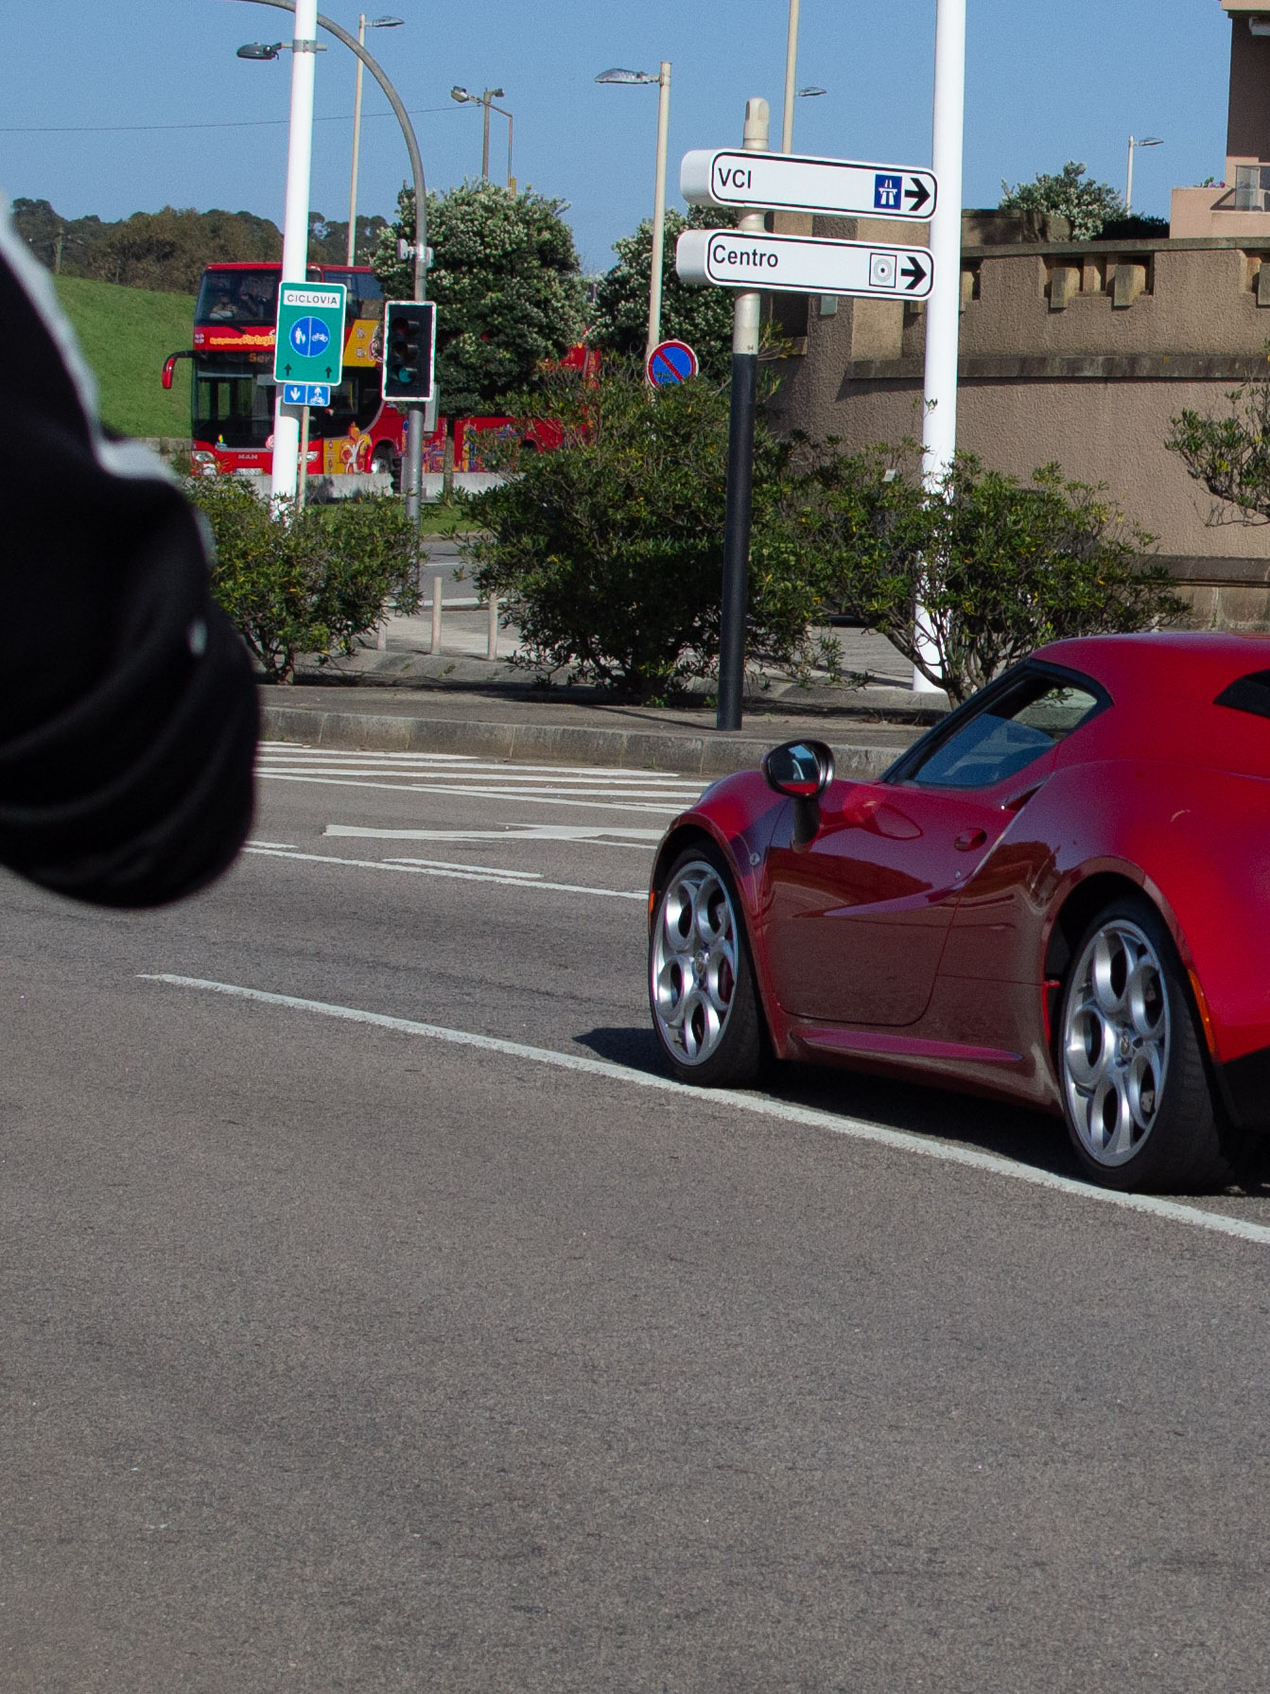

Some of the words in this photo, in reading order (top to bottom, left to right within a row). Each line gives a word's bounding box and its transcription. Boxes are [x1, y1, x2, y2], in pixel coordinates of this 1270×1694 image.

[718, 167, 751, 189] VCI
[713, 244, 778, 268] Centro
[286, 294, 338, 304] CICLOVIA
